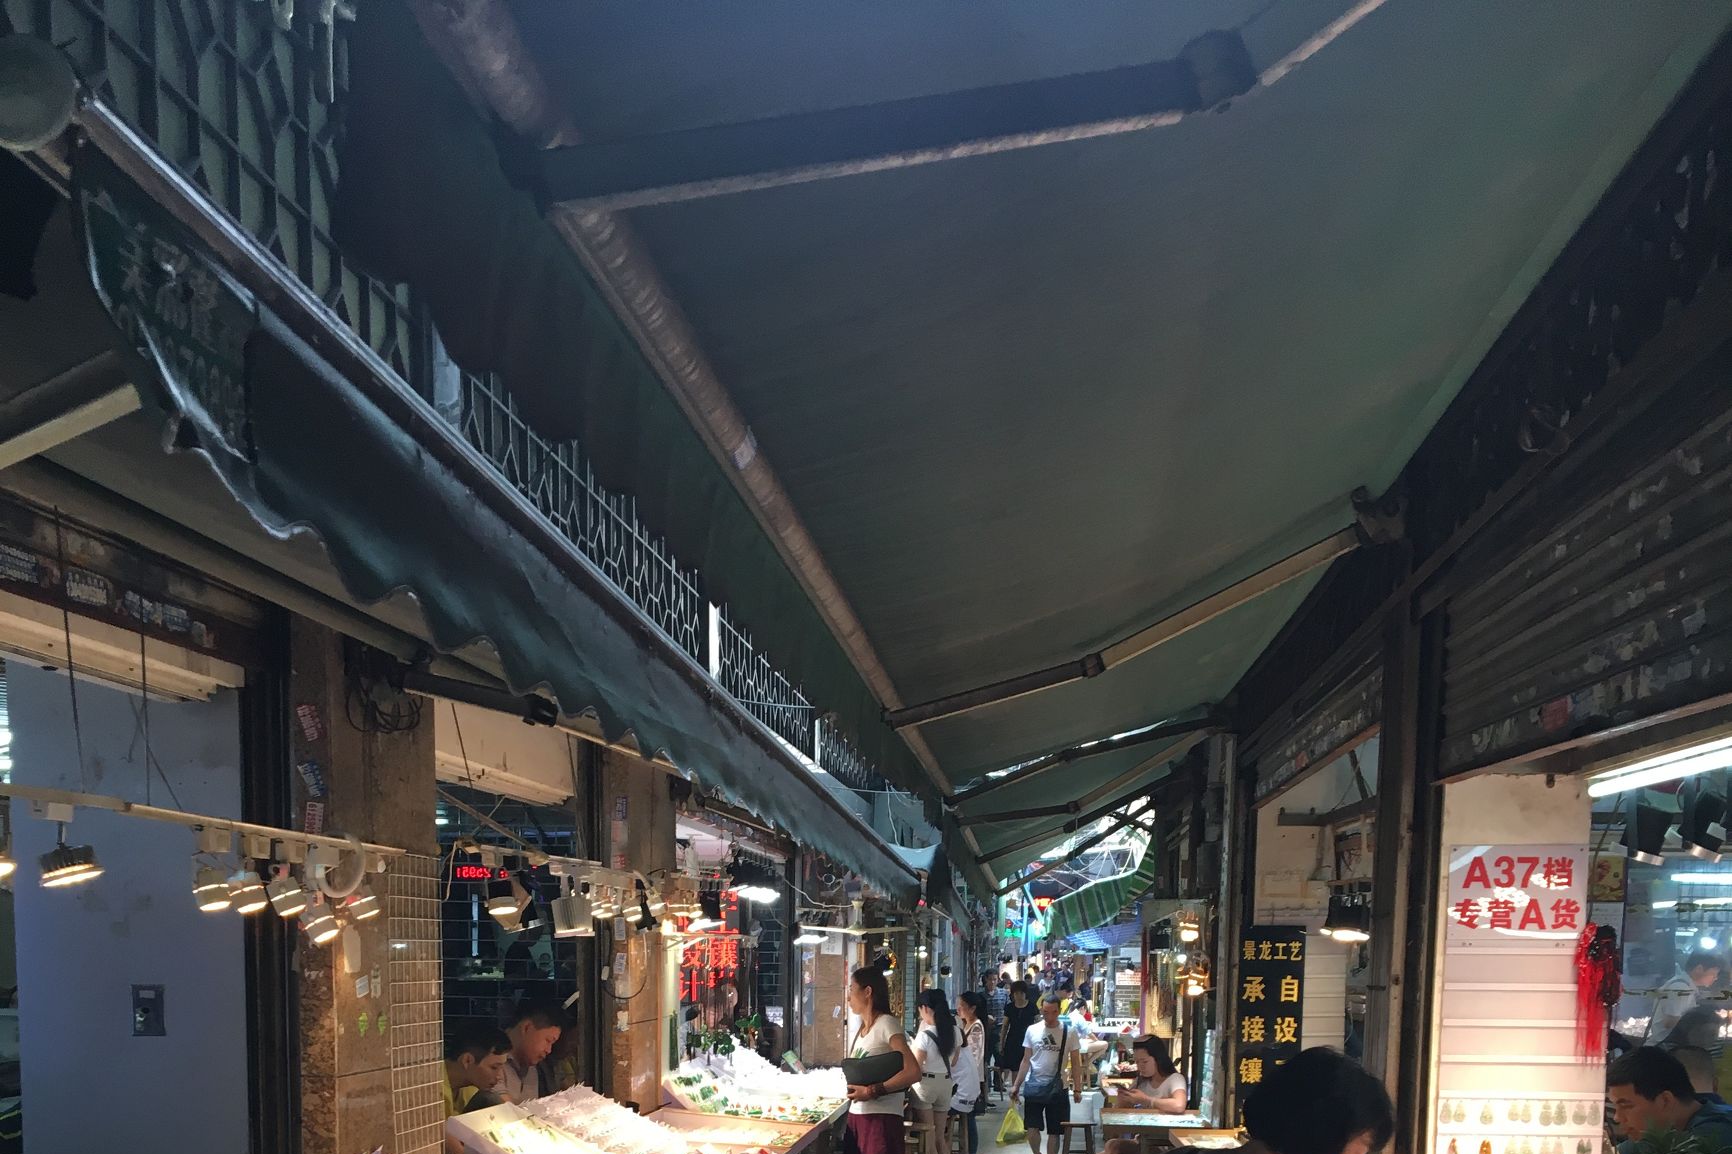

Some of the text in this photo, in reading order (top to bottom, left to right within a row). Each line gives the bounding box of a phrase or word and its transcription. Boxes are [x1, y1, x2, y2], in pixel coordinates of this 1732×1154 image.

[1462, 856, 1574, 889] A37档
[1454, 898, 1581, 930] 专营A货
[1243, 941, 1303, 961] 景龙工艺
[1274, 975, 1299, 1065] 自设
